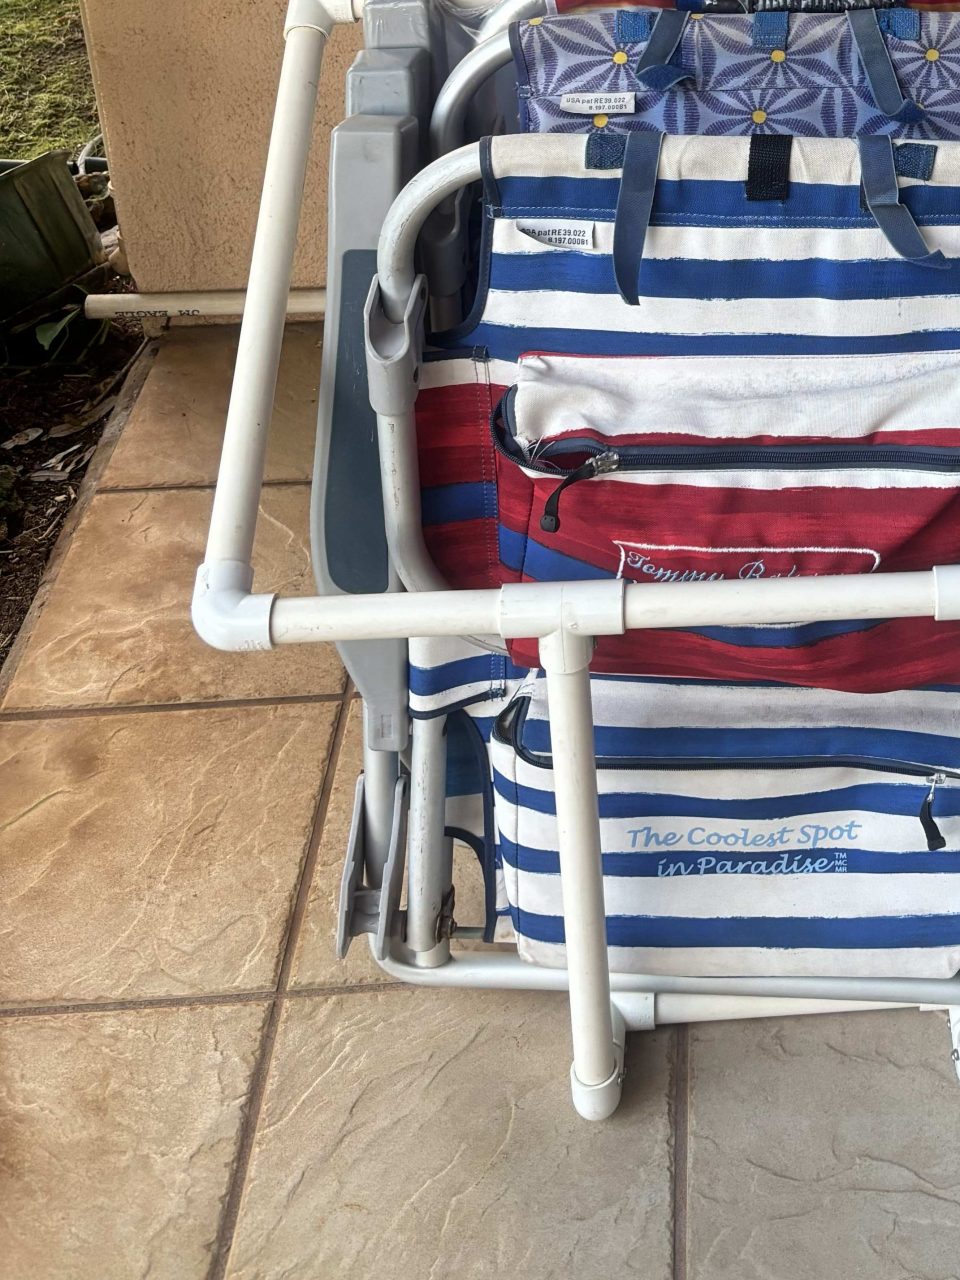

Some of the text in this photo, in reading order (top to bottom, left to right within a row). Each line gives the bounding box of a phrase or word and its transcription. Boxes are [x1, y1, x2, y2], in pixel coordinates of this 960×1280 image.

[114, 310, 168, 318] EAGLE
[627, 820, 863, 848] The Coolest Spot
[657, 853, 834, 877] in Paradise
